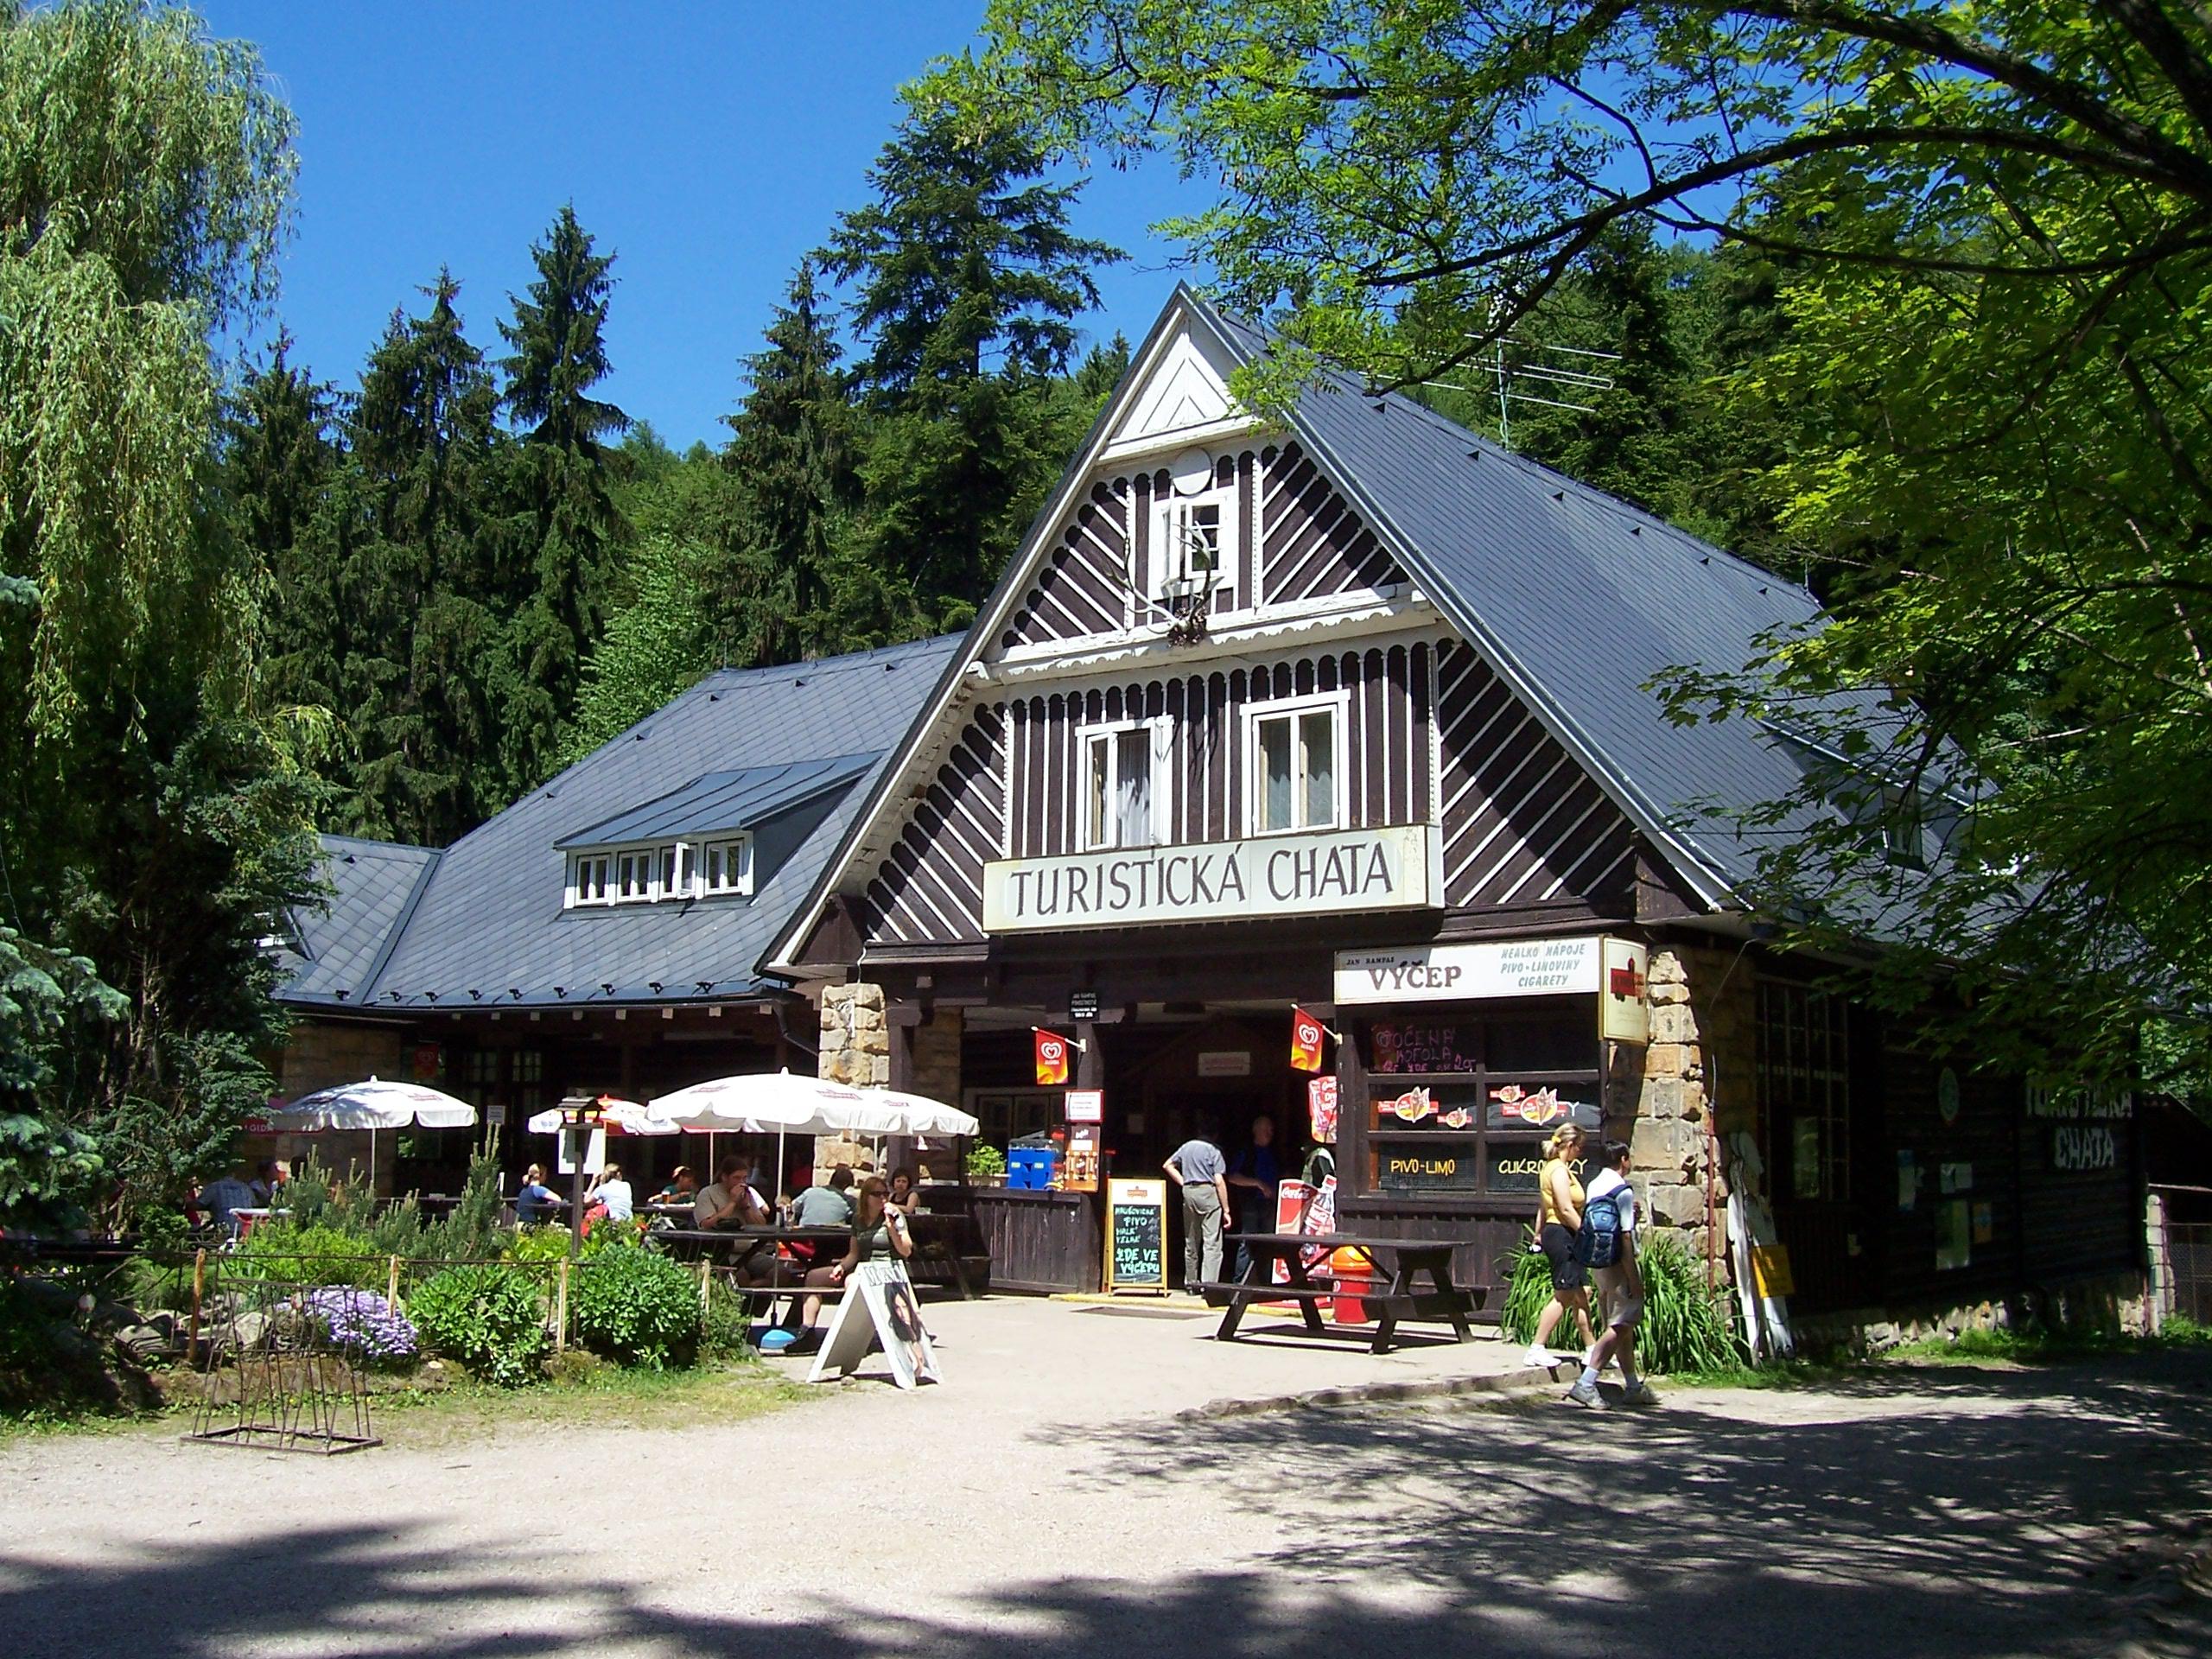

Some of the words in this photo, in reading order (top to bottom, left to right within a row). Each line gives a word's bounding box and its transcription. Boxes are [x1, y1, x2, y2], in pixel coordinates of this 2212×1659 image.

[1010, 843, 1246, 918] TURISTICKÁ
[1268, 841, 1395, 901] CHATA
[1502, 947, 1539, 959] NEALKO
[1546, 943, 1585, 956] NÁPOJE
[1369, 960, 1462, 991] VÝČEP
[1518, 975, 1568, 988] CIGARETY
[2054, 1127, 2115, 1170] CHATA
[1390, 1158, 1456, 1175] PIVO-LIMO
[1123, 1217, 1148, 1228] PIVO
[1143, 1249, 1159, 1262] VE
